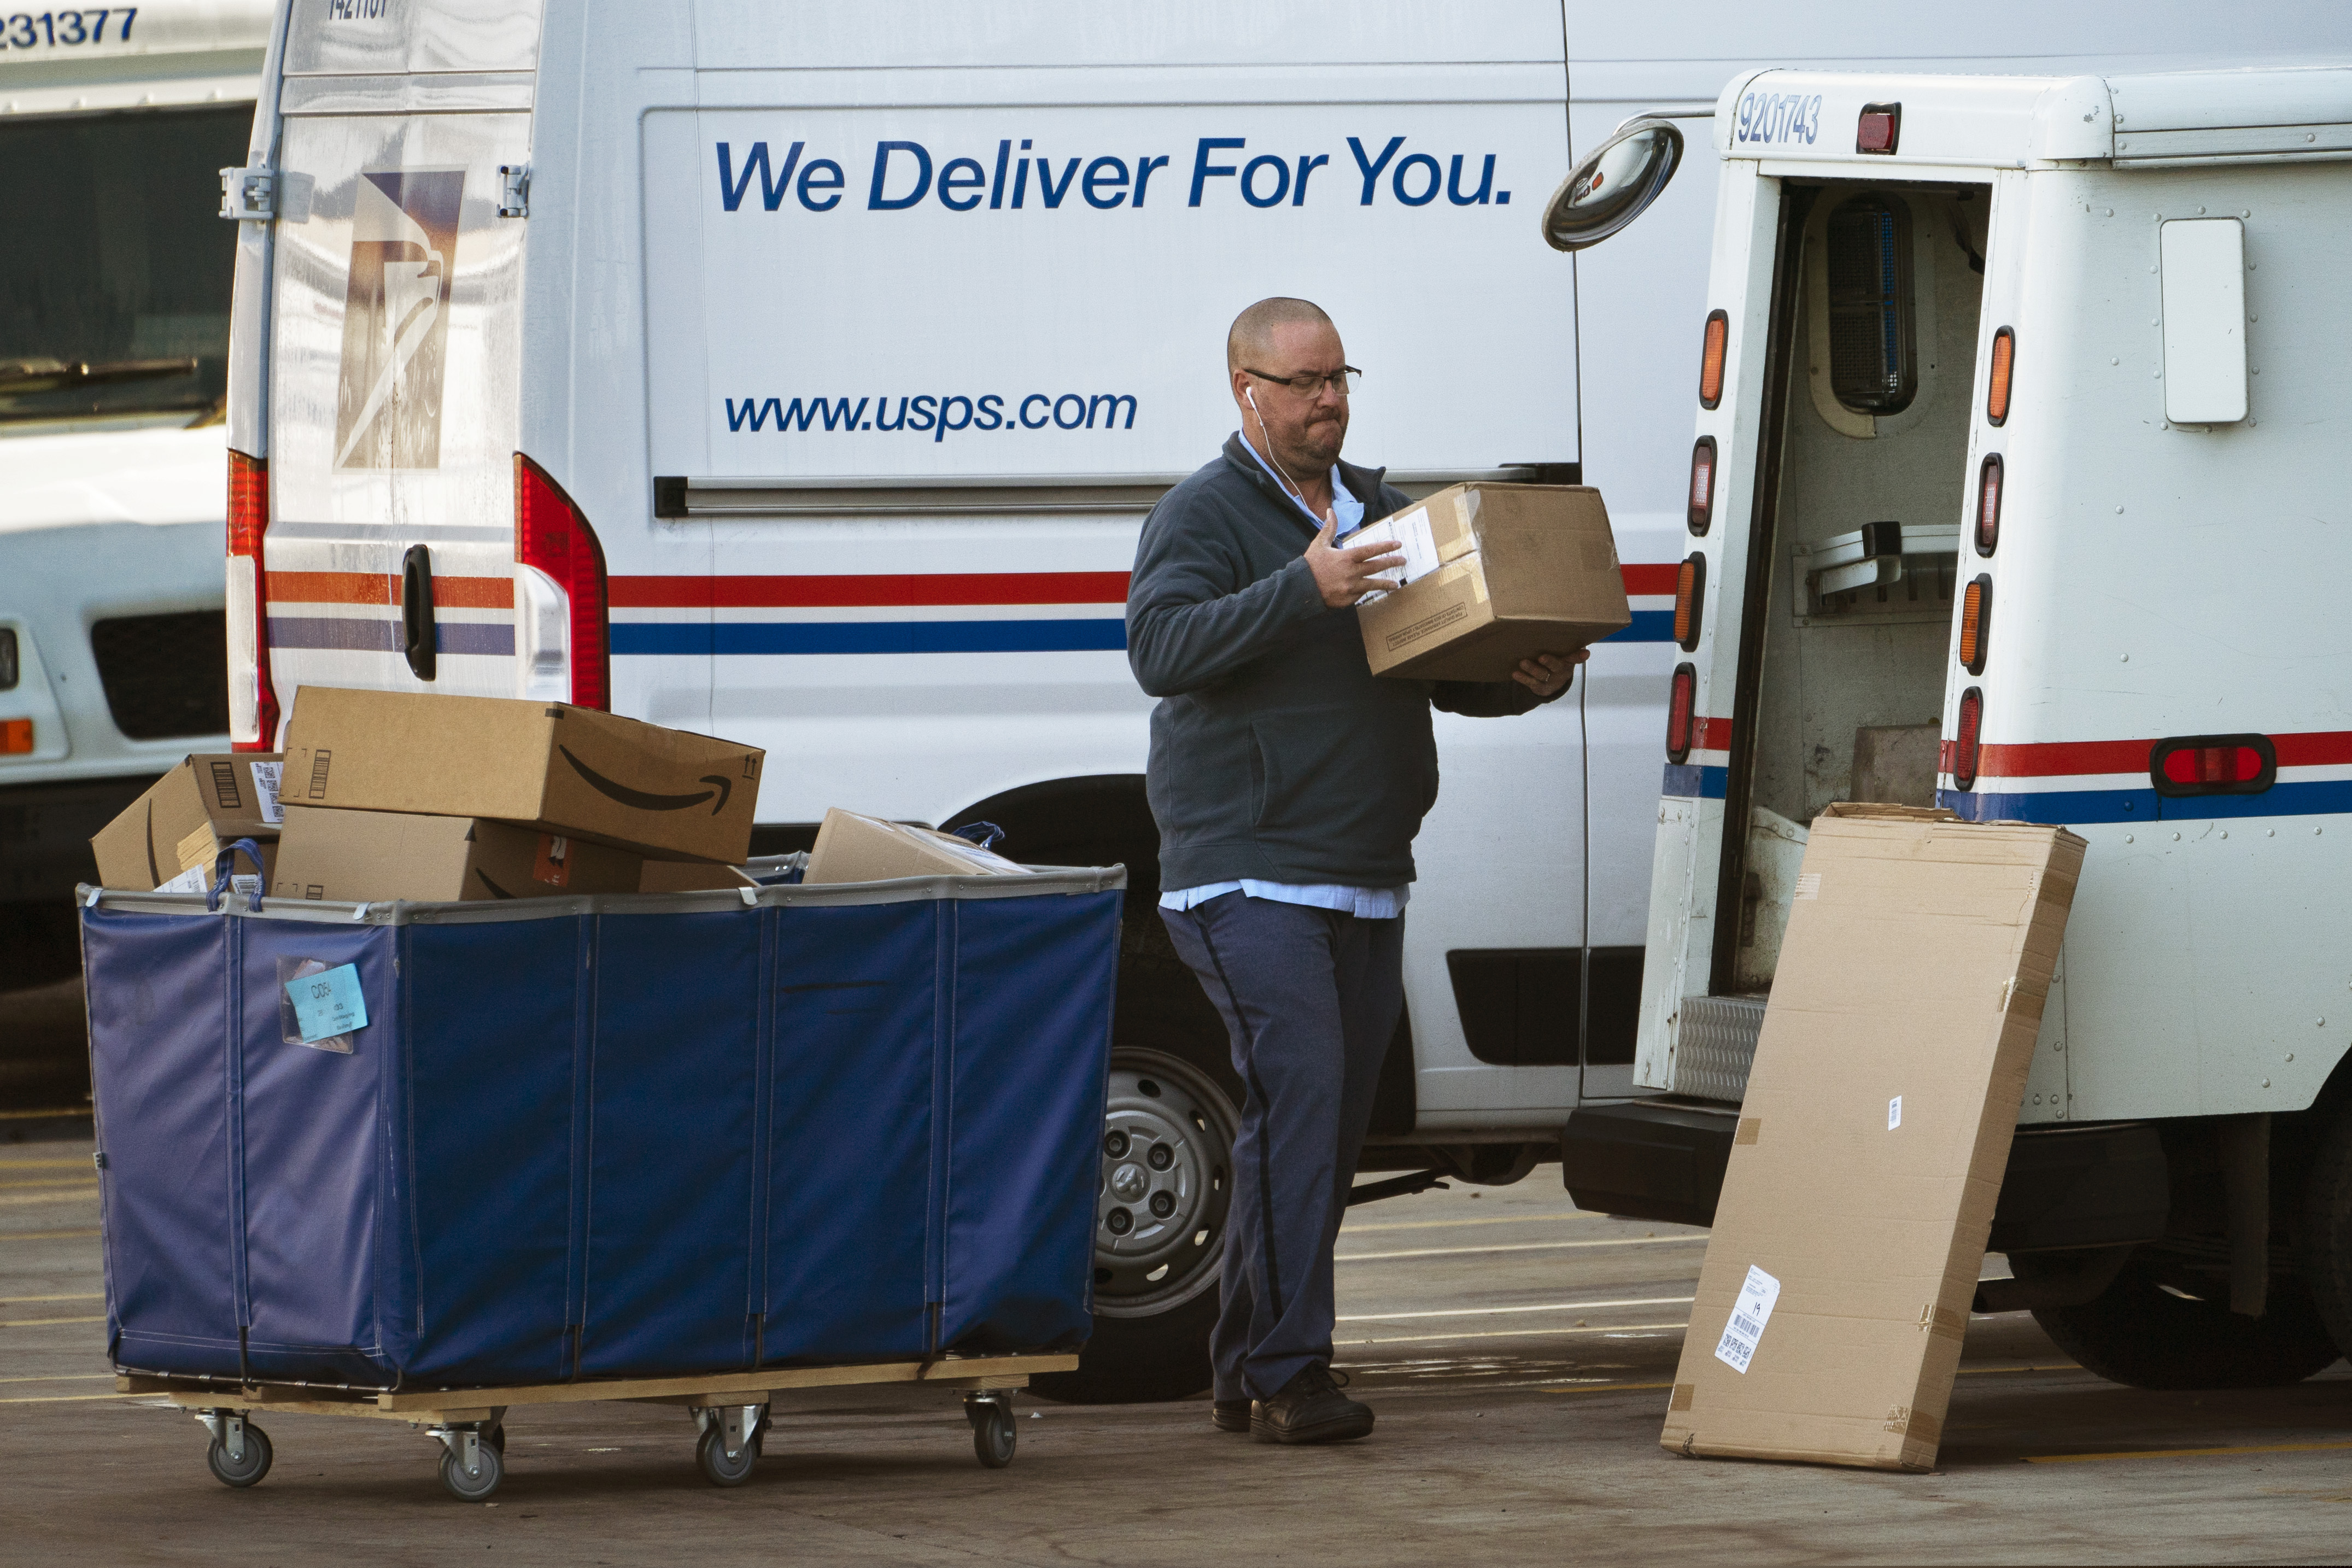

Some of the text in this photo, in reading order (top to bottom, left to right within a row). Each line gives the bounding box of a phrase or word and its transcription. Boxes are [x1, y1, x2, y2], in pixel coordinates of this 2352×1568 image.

[0, 8, 137, 50] 31377
[1739, 92, 1822, 144] 9201743
[716, 136, 1511, 212] We Deliver For You.
[724, 394, 1138, 443] www.usps.com
[1753, 1302, 1760, 1317] 19
